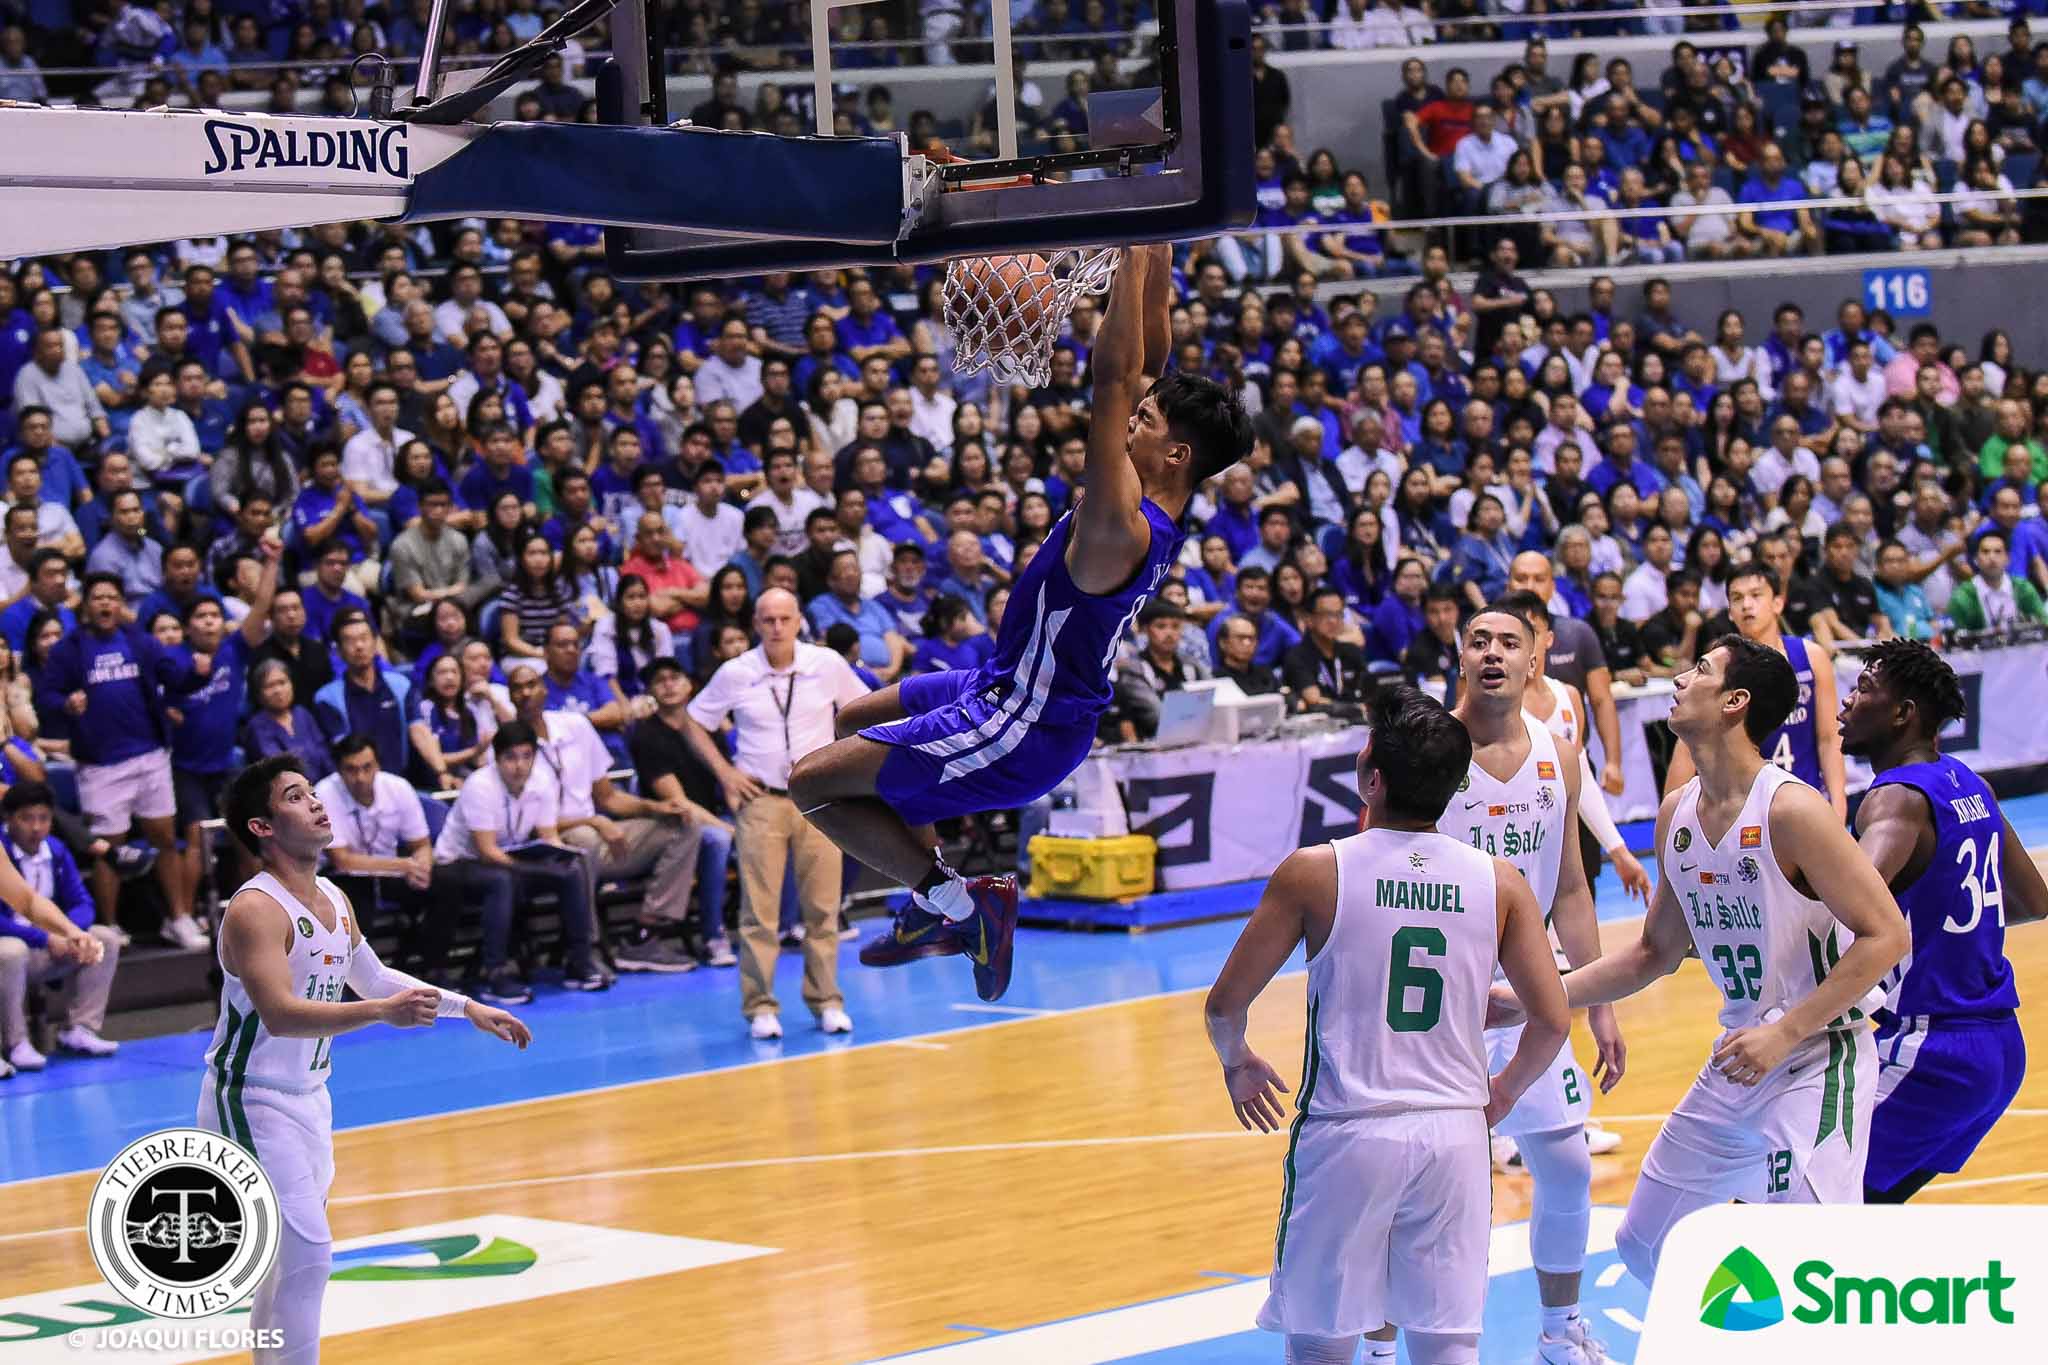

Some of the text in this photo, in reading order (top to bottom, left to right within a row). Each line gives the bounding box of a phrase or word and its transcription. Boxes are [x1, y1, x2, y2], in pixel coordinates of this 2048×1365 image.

[205, 119, 409, 179] SPALDING
[1869, 274, 1929, 310] 116
[1505, 803, 1530, 814] ICTSI
[1375, 878, 1465, 914] MANUEL
[1942, 831, 2006, 934] 34
[1687, 890, 1762, 930] La Salle
[1386, 925, 1448, 1033] 6
[1712, 944, 1763, 1002] 32
[1562, 1067, 1581, 1105] 2
